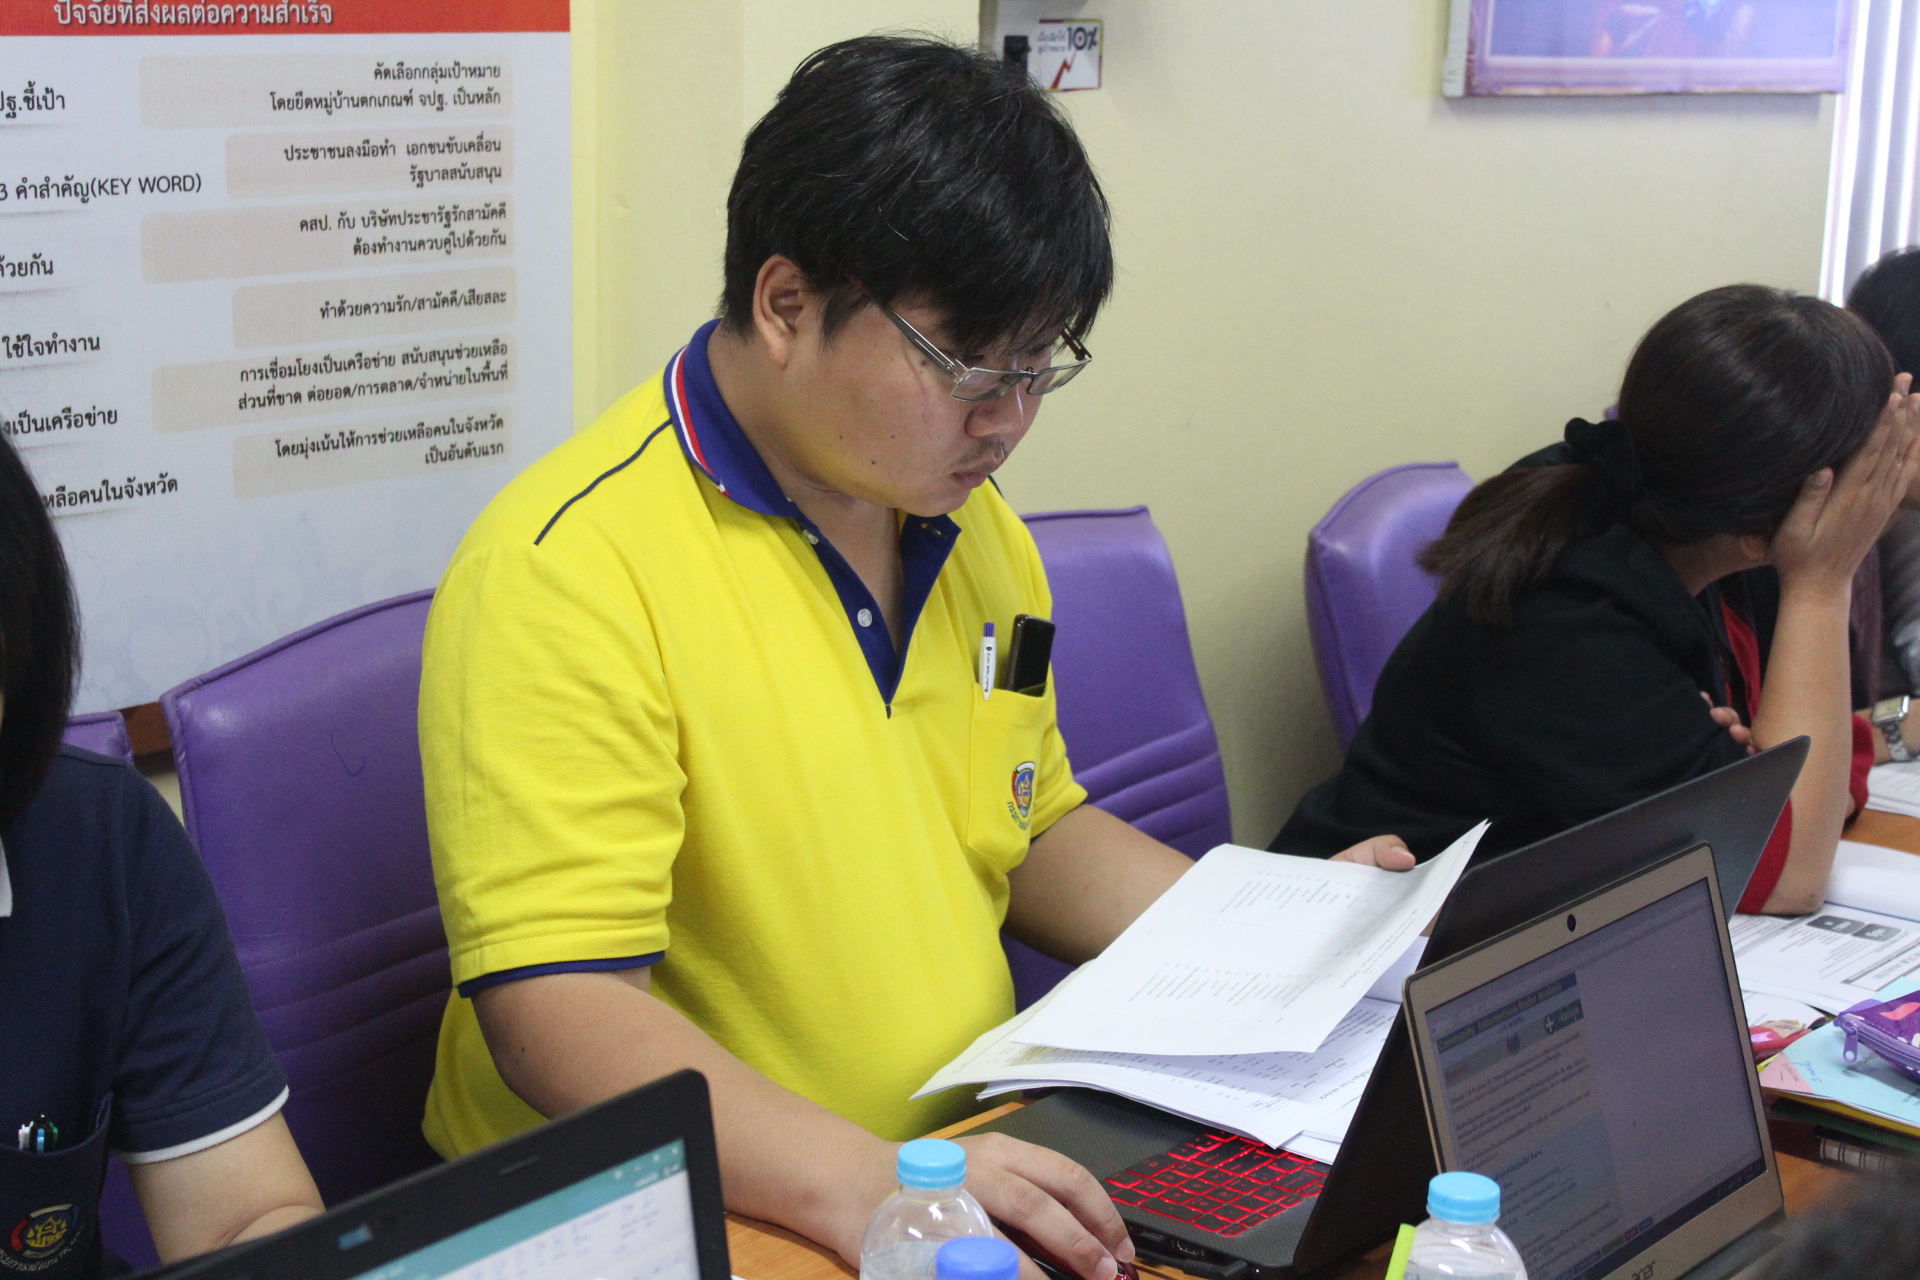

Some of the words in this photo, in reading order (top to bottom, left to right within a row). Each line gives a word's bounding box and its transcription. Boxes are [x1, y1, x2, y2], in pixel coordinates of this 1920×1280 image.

[373, 62, 501, 84] คัดเลือกกลุ่มเป้าหมาย
[452, 86, 501, 106] เป็นหลัก
[284, 138, 396, 161] ประชาชนลงมือทำ
[406, 131, 501, 155] เอกชนขับเคลื่อน
[138, 172, 202, 194] WORD)
[409, 162, 502, 188] รัฐบาลสนับสนุน
[337, 211, 356, 230] กับ
[2, 332, 101, 359] ใช้ใจทำงาน
